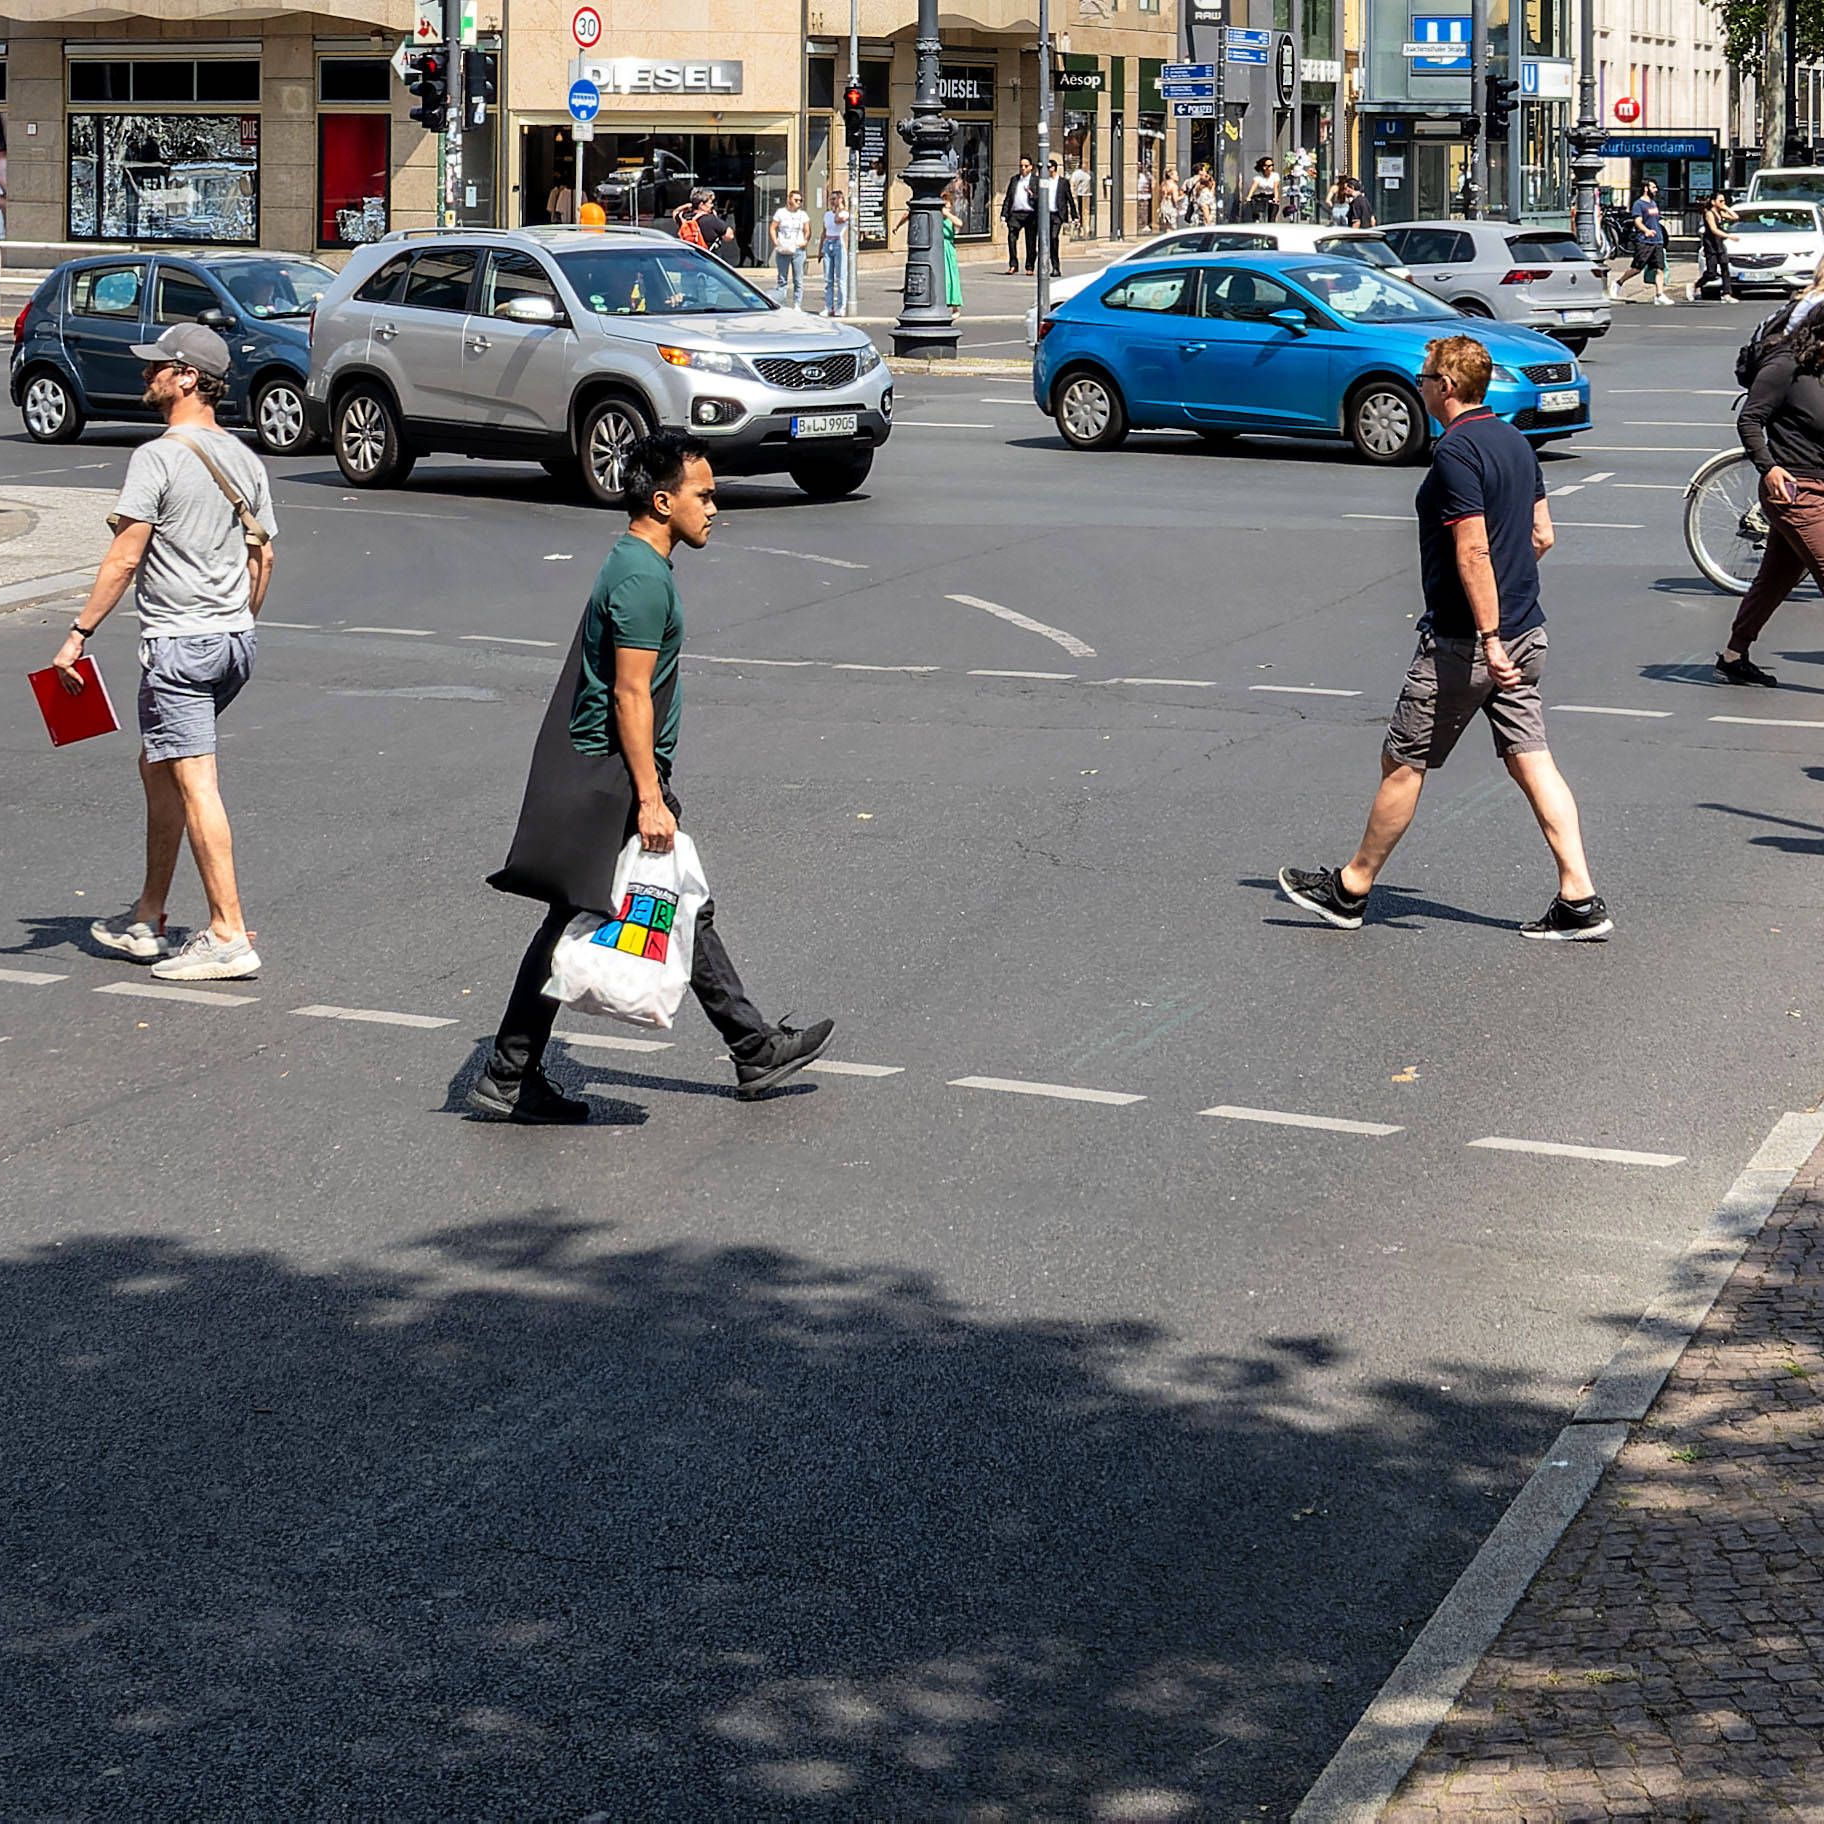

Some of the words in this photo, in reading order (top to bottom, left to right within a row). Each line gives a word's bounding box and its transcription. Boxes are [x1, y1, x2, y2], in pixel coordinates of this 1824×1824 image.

[577, 17, 596, 37] 30
[1426, 21, 1462, 65] U
[582, 65, 733, 88] DIESEL
[1524, 63, 1535, 92] U
[939, 78, 980, 99] DIESEL
[242, 120, 258, 139] DIE
[1385, 121, 1397, 134] U
[1600, 141, 1695, 154] Kurfürstendamm
[799, 419, 805, 433] B
[812, 417, 828, 432] LJ
[829, 416, 855, 432] 9905
